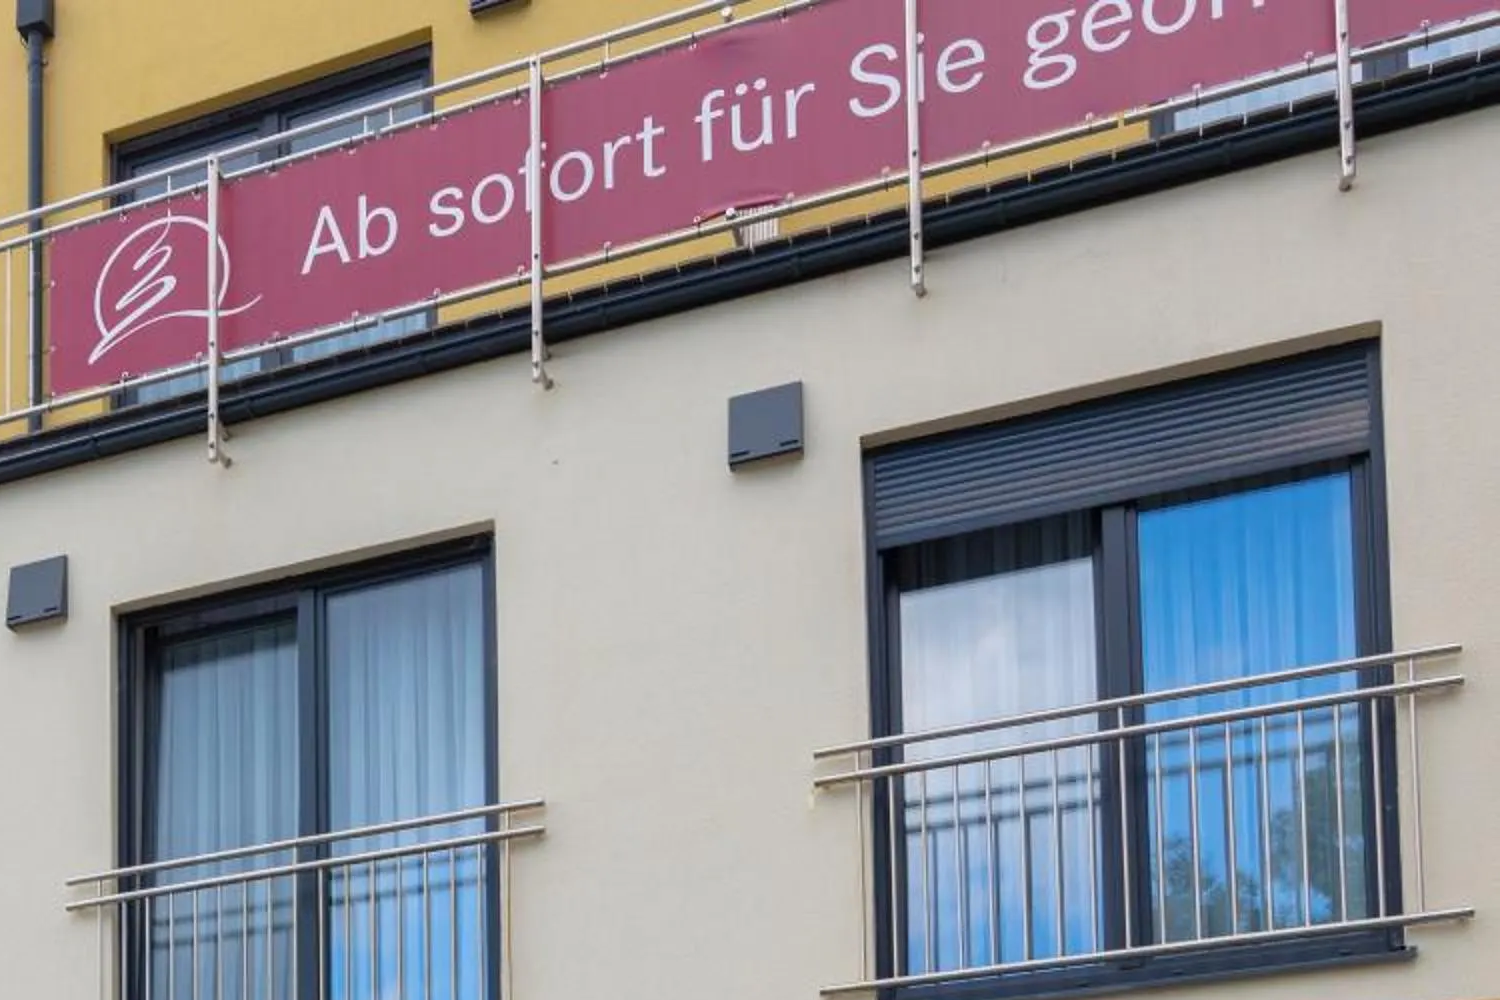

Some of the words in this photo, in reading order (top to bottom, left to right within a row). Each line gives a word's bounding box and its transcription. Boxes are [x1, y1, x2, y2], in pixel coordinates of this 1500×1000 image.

[301, 194, 398, 275] Ab
[428, 115, 665, 238] sofort
[693, 77, 816, 162] für
[848, 32, 986, 118] Sie
